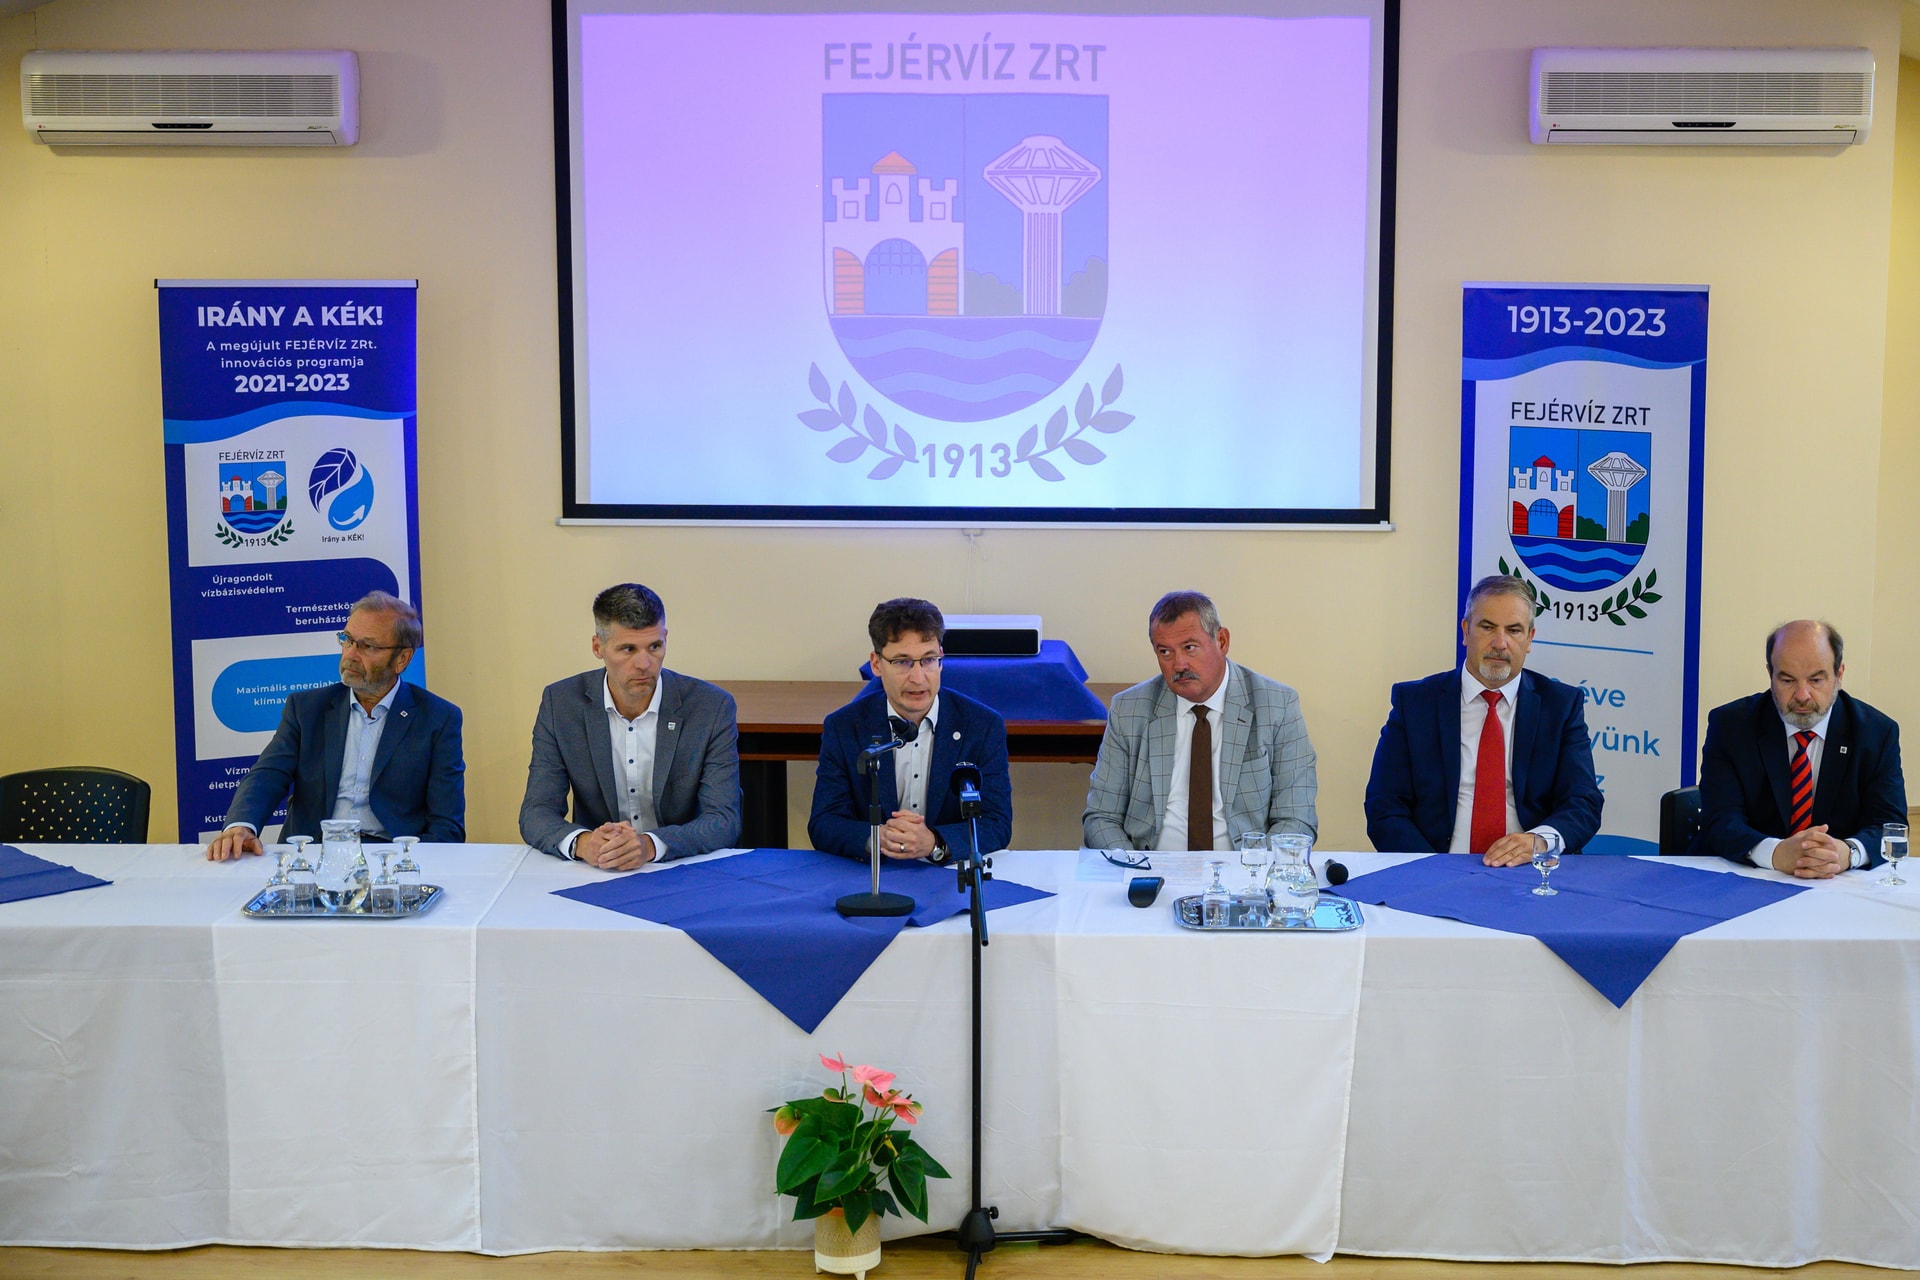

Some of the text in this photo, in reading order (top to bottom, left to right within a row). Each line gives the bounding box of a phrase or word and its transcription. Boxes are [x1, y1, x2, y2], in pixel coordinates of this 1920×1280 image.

[824, 31, 1107, 82] FEJÉRVÍZ ZRT
[197, 300, 384, 327] IRÁNY A KÉK!
[1507, 305, 1667, 337] 1913-2023
[206, 338, 377, 353] A megújult FEJÉRVÍZ ZRt.
[221, 355, 365, 369] innovációs programja
[234, 373, 350, 393] 2021-2023
[1511, 398, 1651, 426] FEJÉRVÍZ ZRT
[218, 449, 285, 461] FEJÉRVÍZ ZRT
[922, 442, 1011, 478] 1913
[244, 537, 267, 547] 1913
[321, 535, 340, 544] Irány
[347, 533, 365, 542] KÉK!
[212, 572, 273, 585] Újragondolt
[201, 584, 285, 598] vízbázisvédelem
[1553, 601, 1599, 622] 1913
[236, 682, 287, 695] Maximális
[254, 696, 287, 706] klímav
[224, 766, 250, 776] Vízm
[208, 779, 241, 790] életpá
